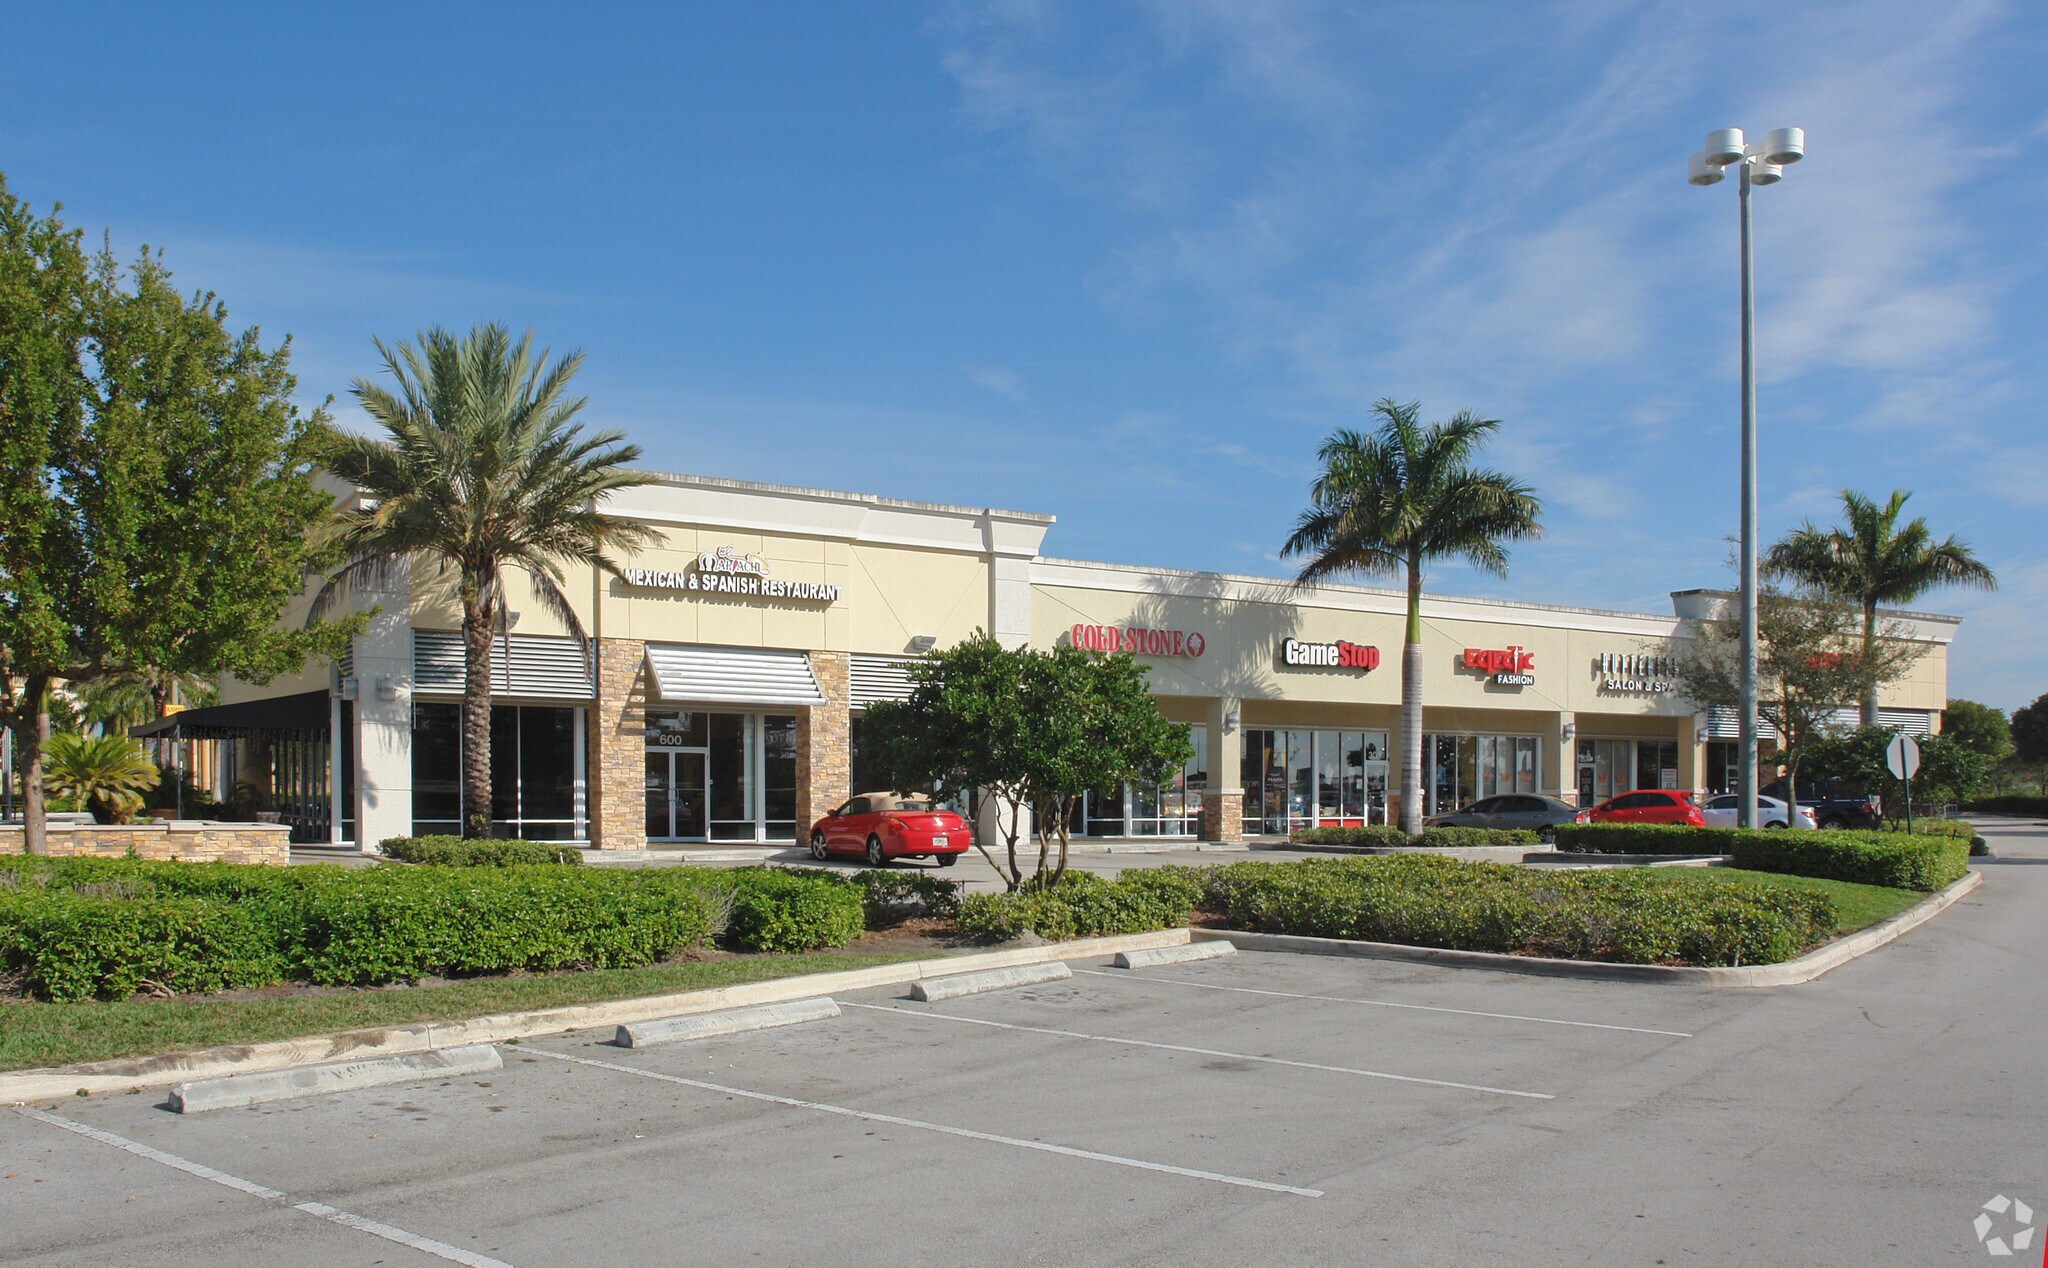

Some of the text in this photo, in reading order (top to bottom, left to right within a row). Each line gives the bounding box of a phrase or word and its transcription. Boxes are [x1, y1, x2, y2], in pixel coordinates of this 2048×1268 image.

[624, 568, 843, 601] MEXICAN & SPANISH RESTAURANT
[1071, 623, 1184, 656] COLD STONE
[1286, 639, 1380, 671] GameStop
[1497, 674, 1534, 685] FASHION
[1607, 680, 1643, 691] SALON
[1644, 682, 1653, 692] &
[660, 734, 682, 746] 600
